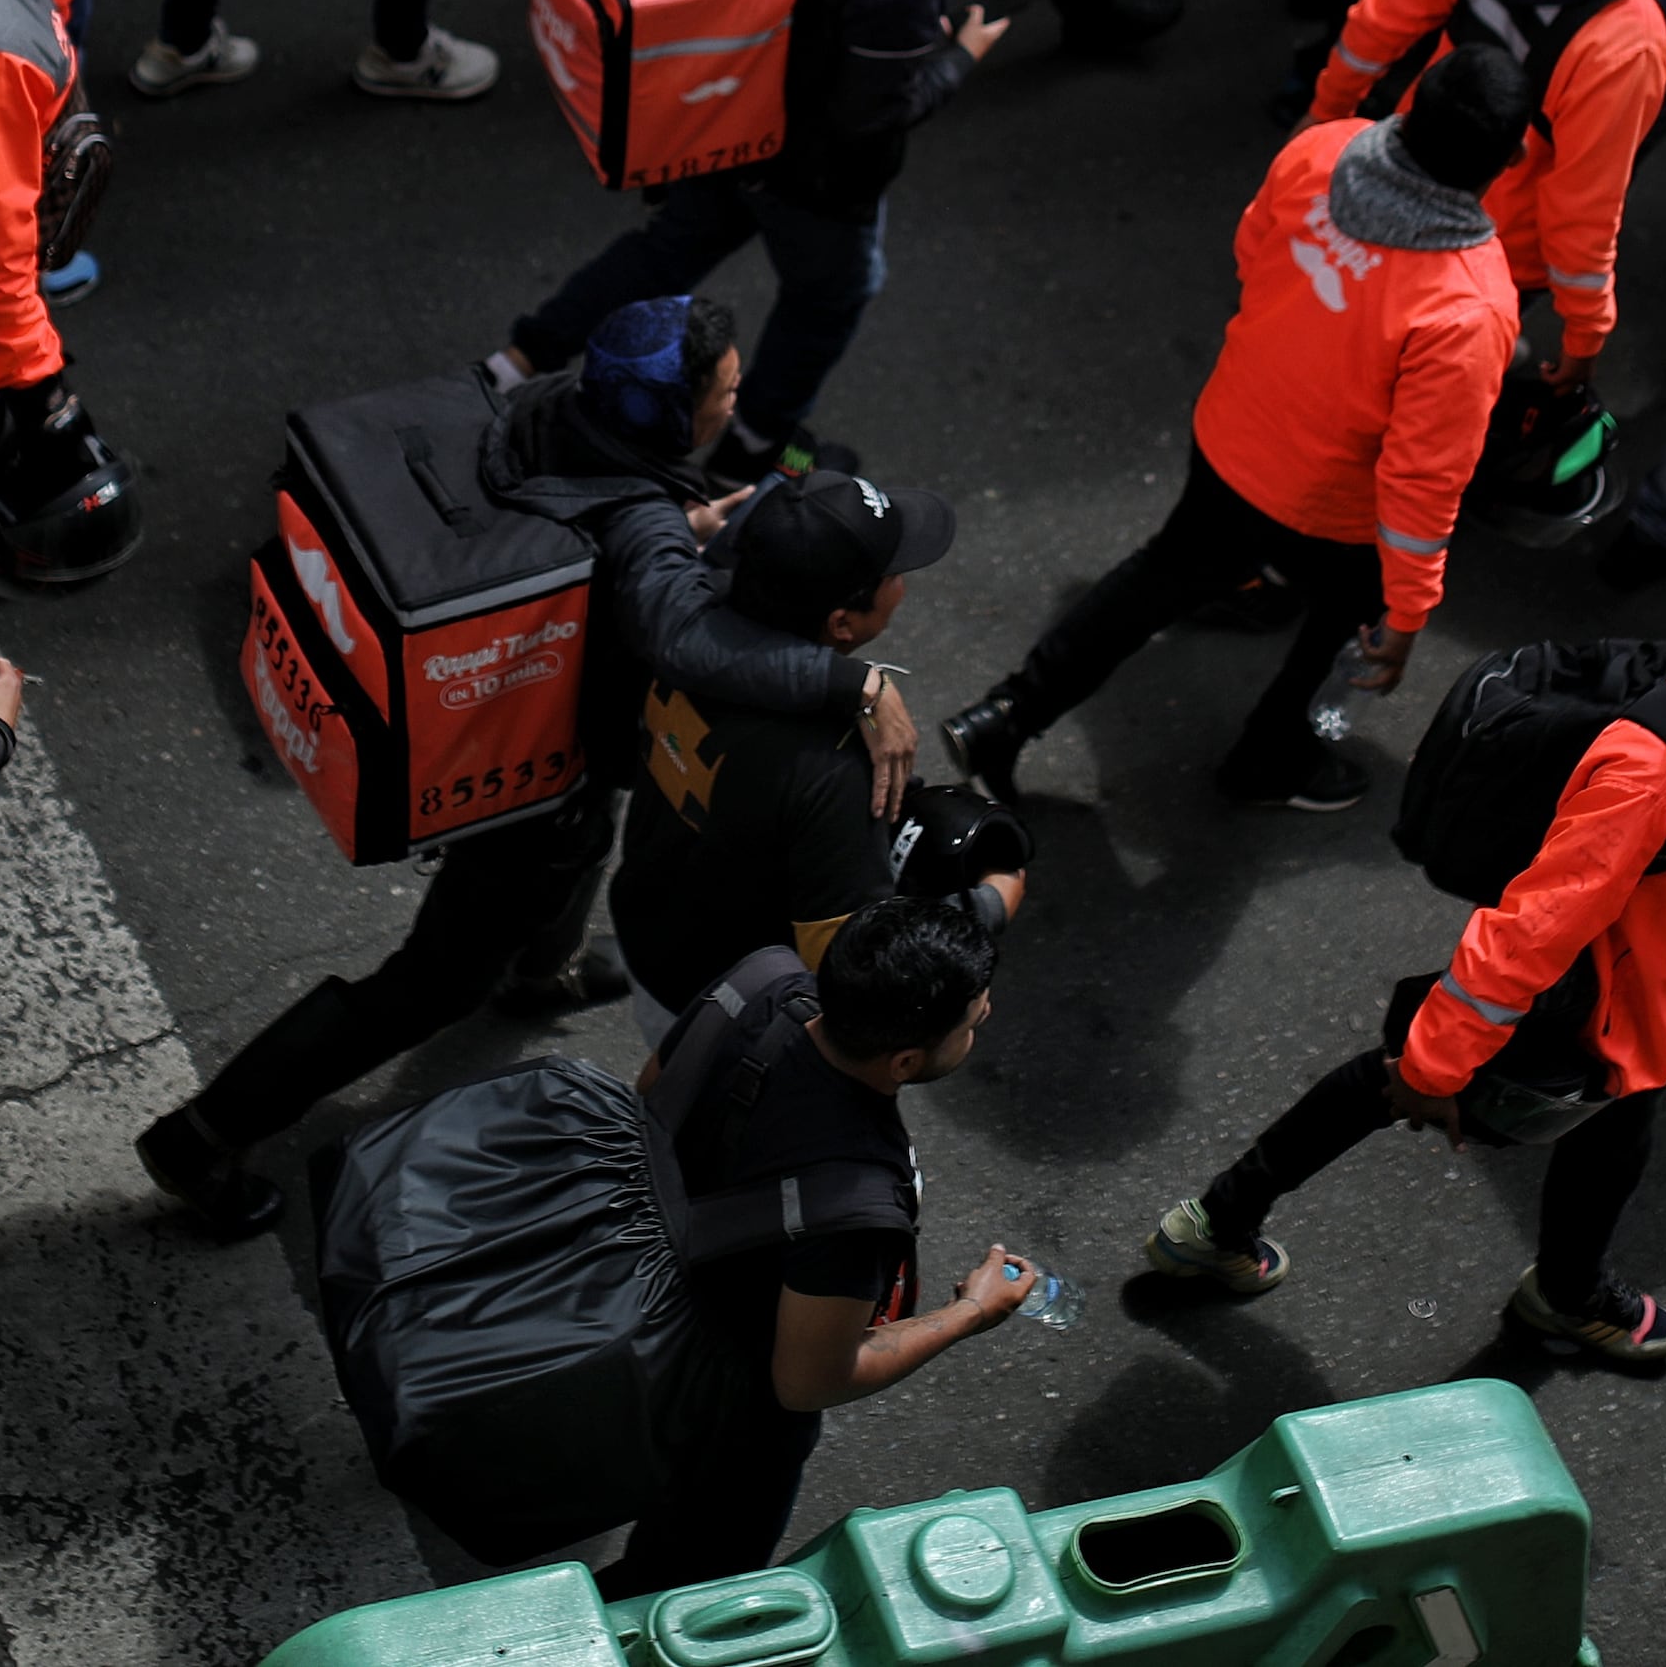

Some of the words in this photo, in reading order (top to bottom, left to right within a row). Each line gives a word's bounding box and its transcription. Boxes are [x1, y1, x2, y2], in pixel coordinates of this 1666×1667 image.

[422, 638, 502, 682] Rappi
[504, 620, 580, 659] Turbo
[471, 677, 501, 700] 10
[420, 739, 582, 816] 85533
